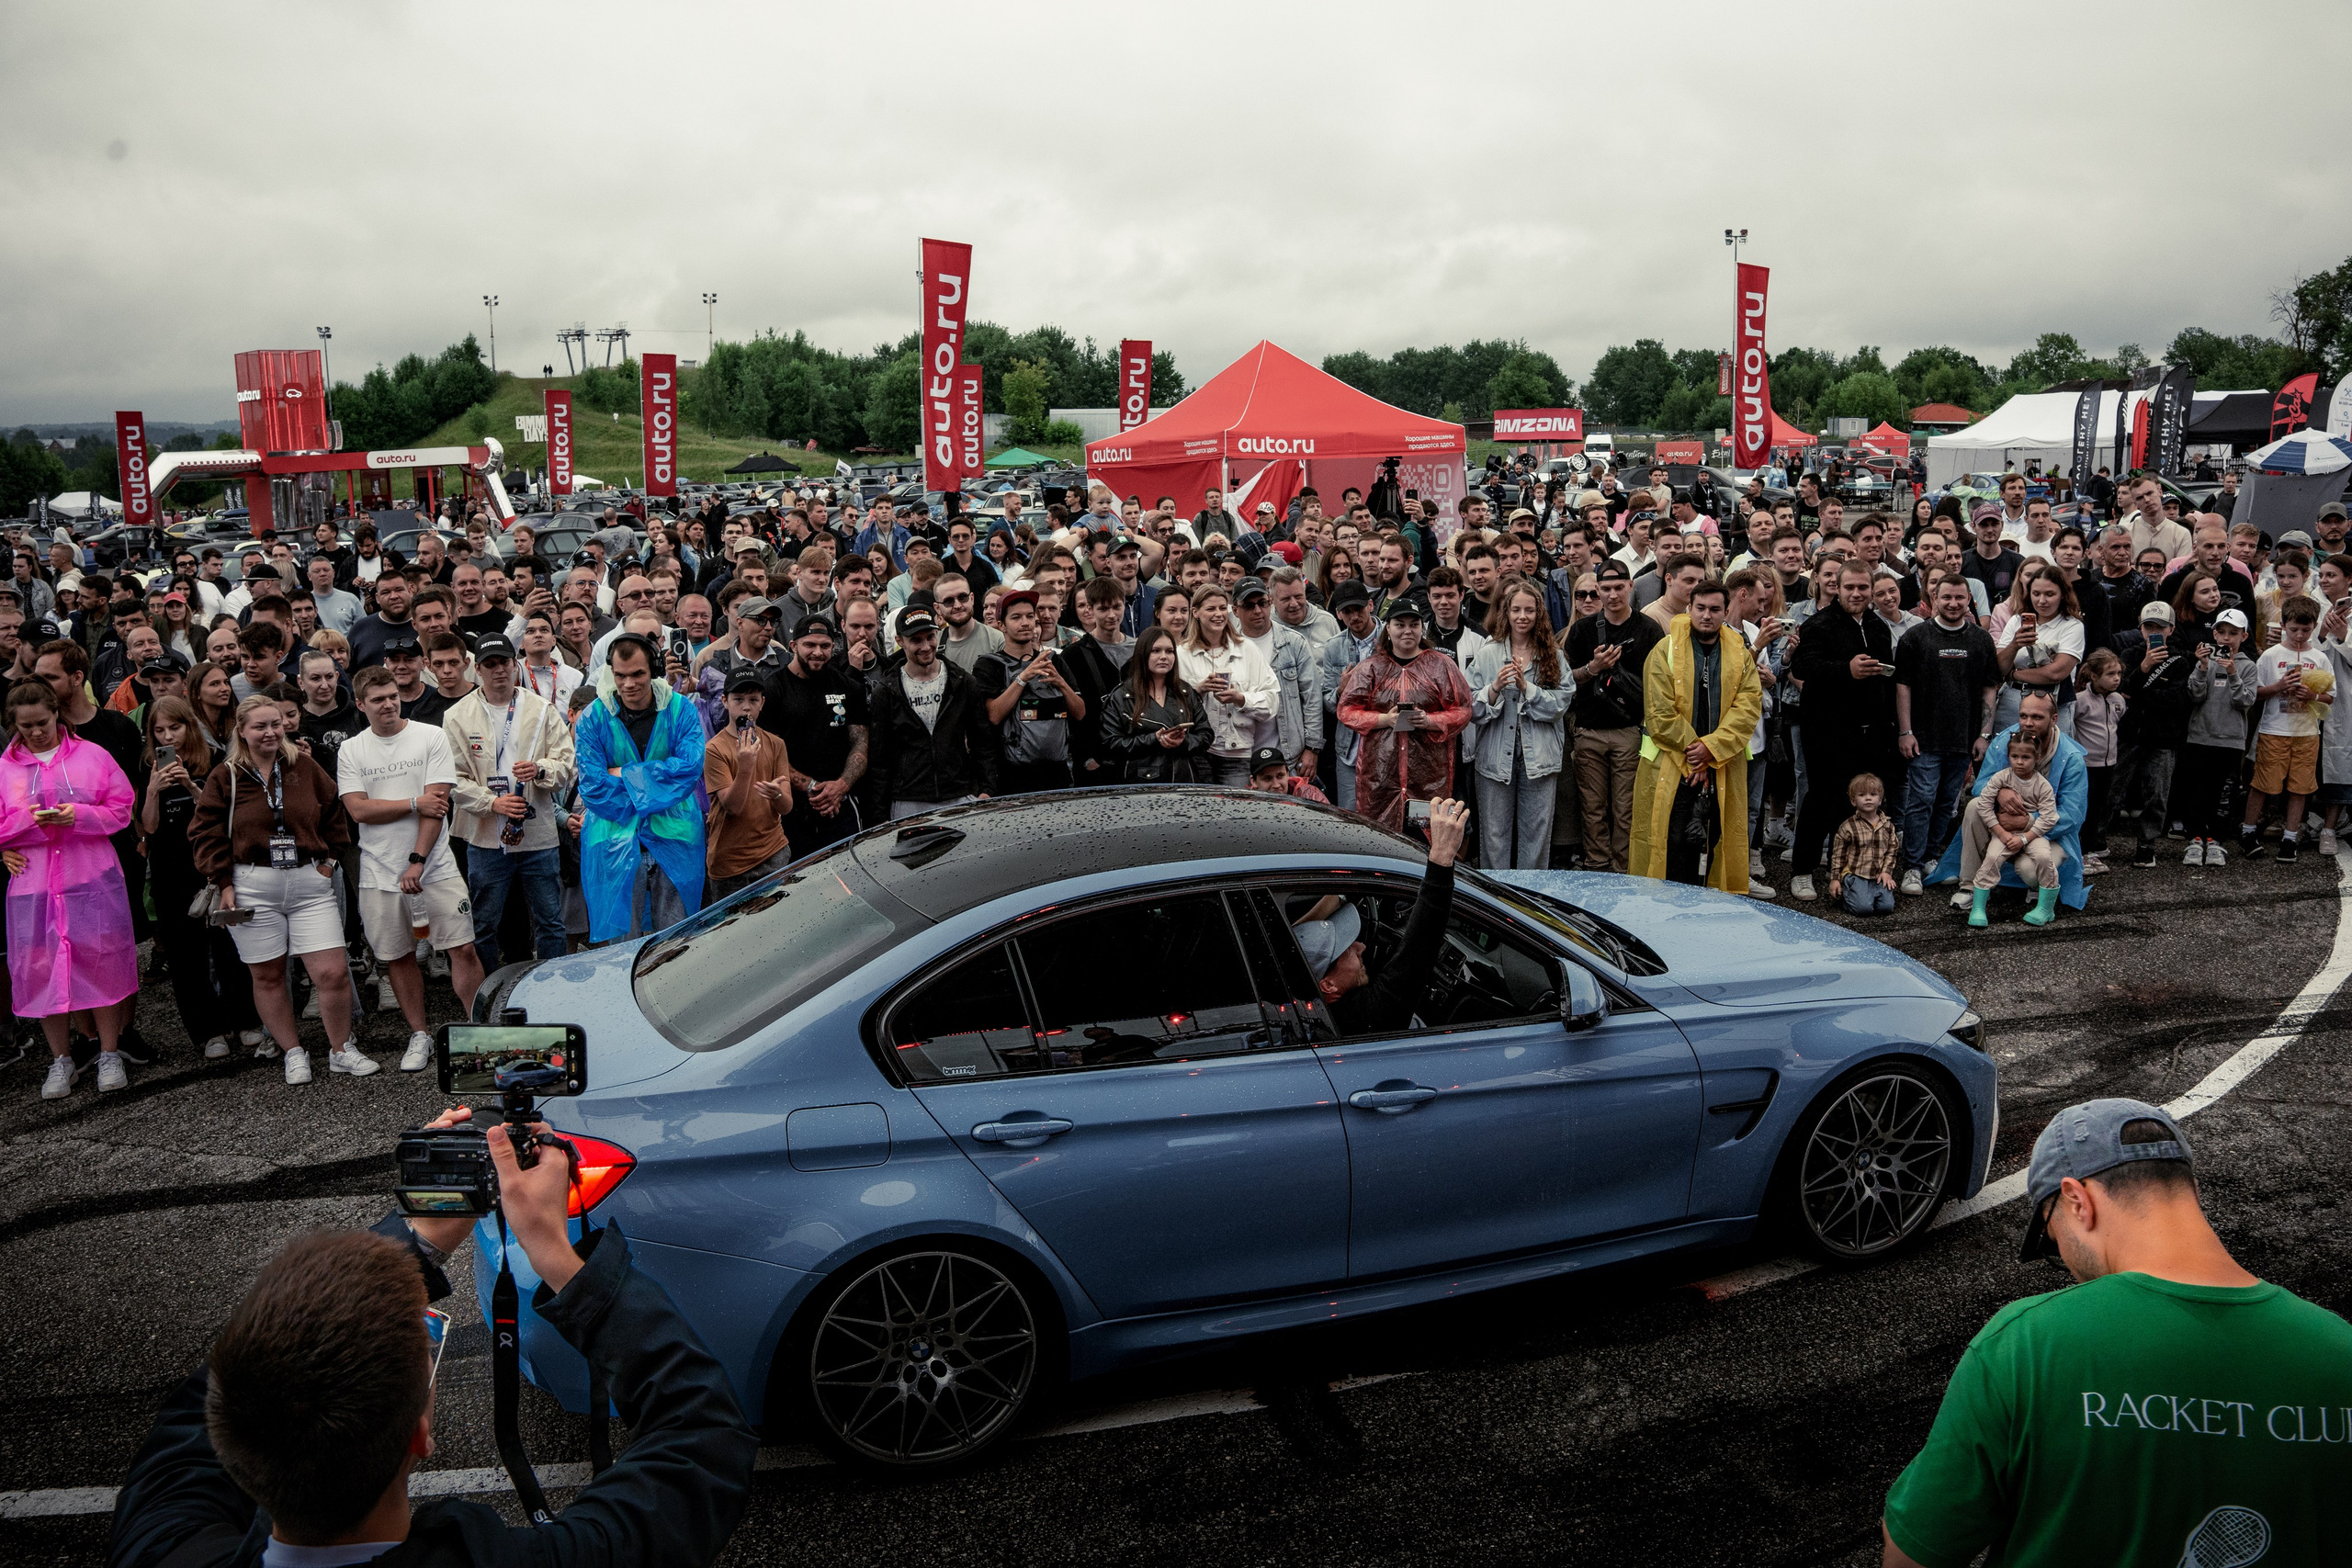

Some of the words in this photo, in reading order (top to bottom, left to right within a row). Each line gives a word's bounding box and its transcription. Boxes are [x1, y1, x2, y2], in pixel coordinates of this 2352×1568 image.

[930, 273, 961, 468] auto.ru
[1743, 290, 1766, 451] auto.ru
[237, 389, 261, 402] auto.ru
[1123, 357, 1147, 432] to.ru
[2164, 383, 2174, 412] НЕТ
[2080, 395, 2091, 419] НЕТ
[515, 415, 548, 430] BIMM
[651, 372, 672, 484] auto.ru
[960, 379, 979, 468] auto.ru
[1494, 417, 1577, 433] RIMZONA
[554, 403, 571, 485] auto.ru
[1091, 447, 1132, 464] auto.ru
[1238, 436, 1315, 453] auto.ru
[1408, 442, 1439, 450] продаются
[125, 425, 149, 514] auto.ru
[376, 454, 416, 464] auto.ru
[387, 772, 408, 780] STOCKHOLM
[388, 759, 423, 772] O'Polo
[2081, 1391, 2255, 1438] RACKET
